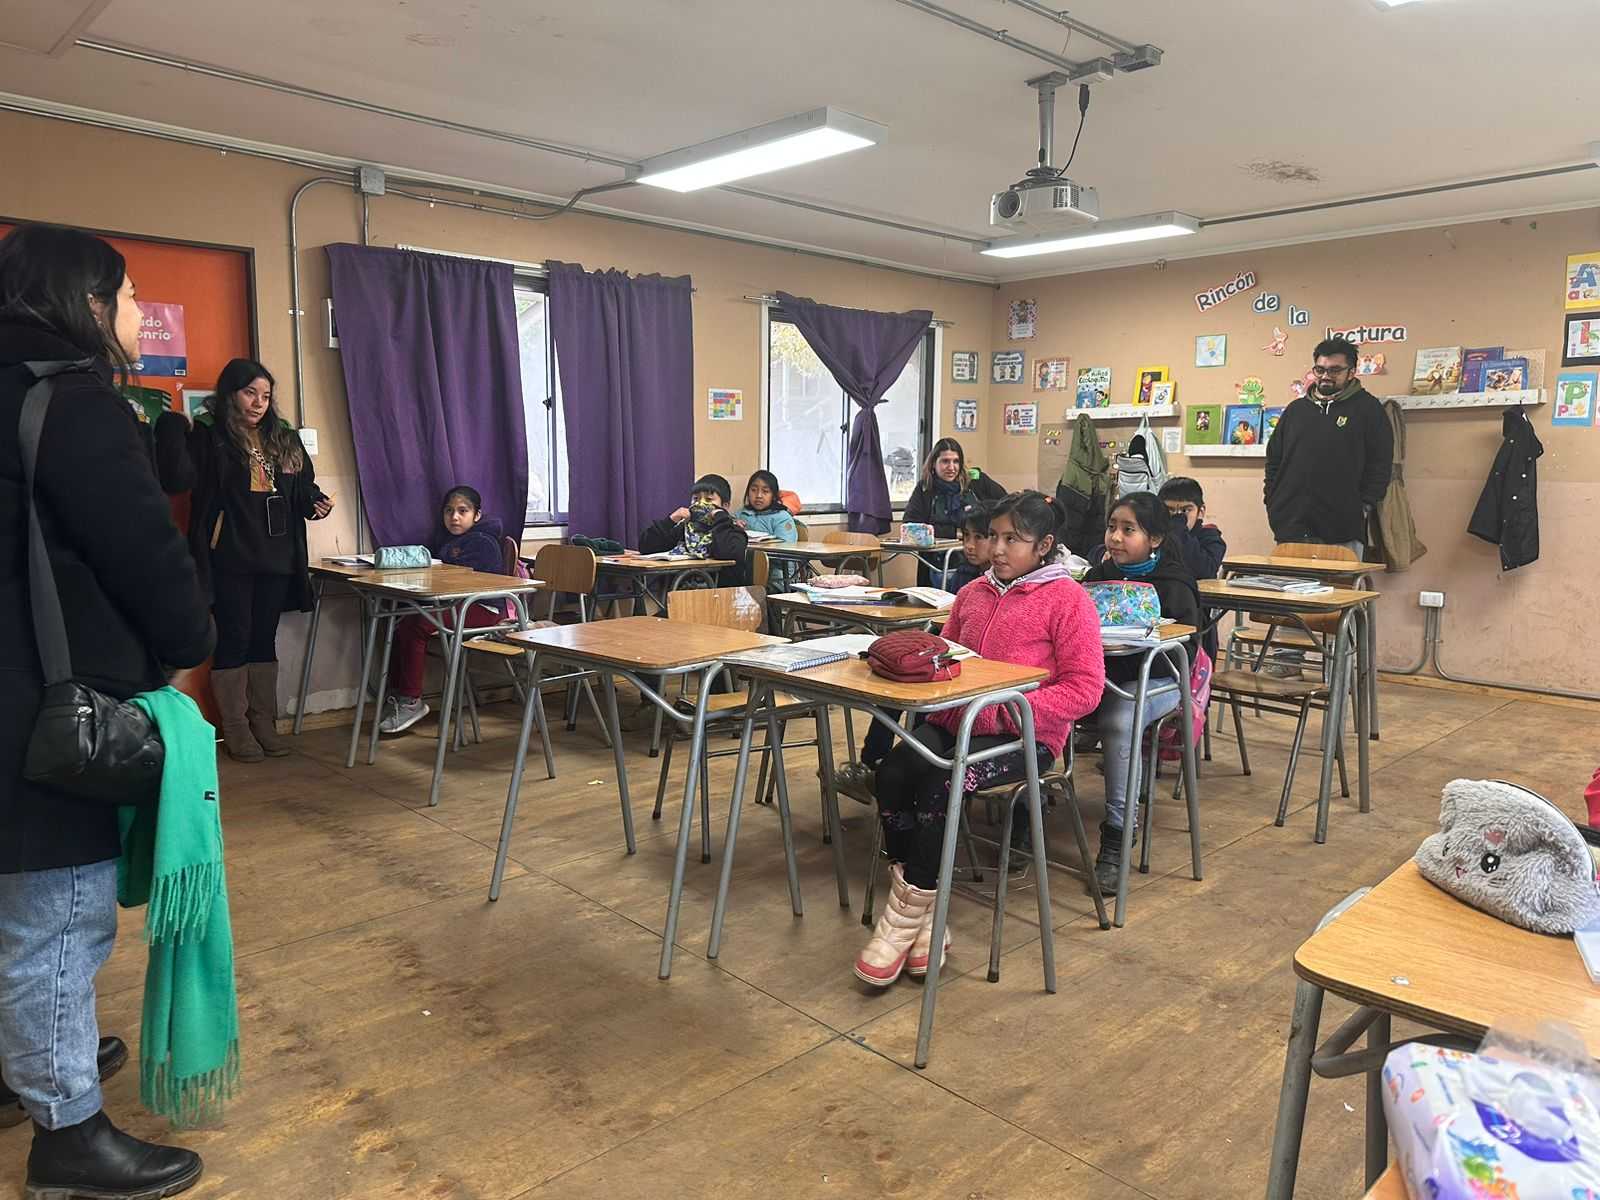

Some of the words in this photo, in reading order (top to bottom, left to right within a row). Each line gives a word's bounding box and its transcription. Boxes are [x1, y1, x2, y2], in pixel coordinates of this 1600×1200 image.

[1571, 263, 1597, 288] A
[1197, 271, 1255, 311] Rincón
[1253, 293, 1279, 311] de
[1289, 307, 1308, 325] la
[1327, 326, 1405, 342] lectura
[1565, 381, 1588, 405] P
[1558, 405, 1569, 416] p
